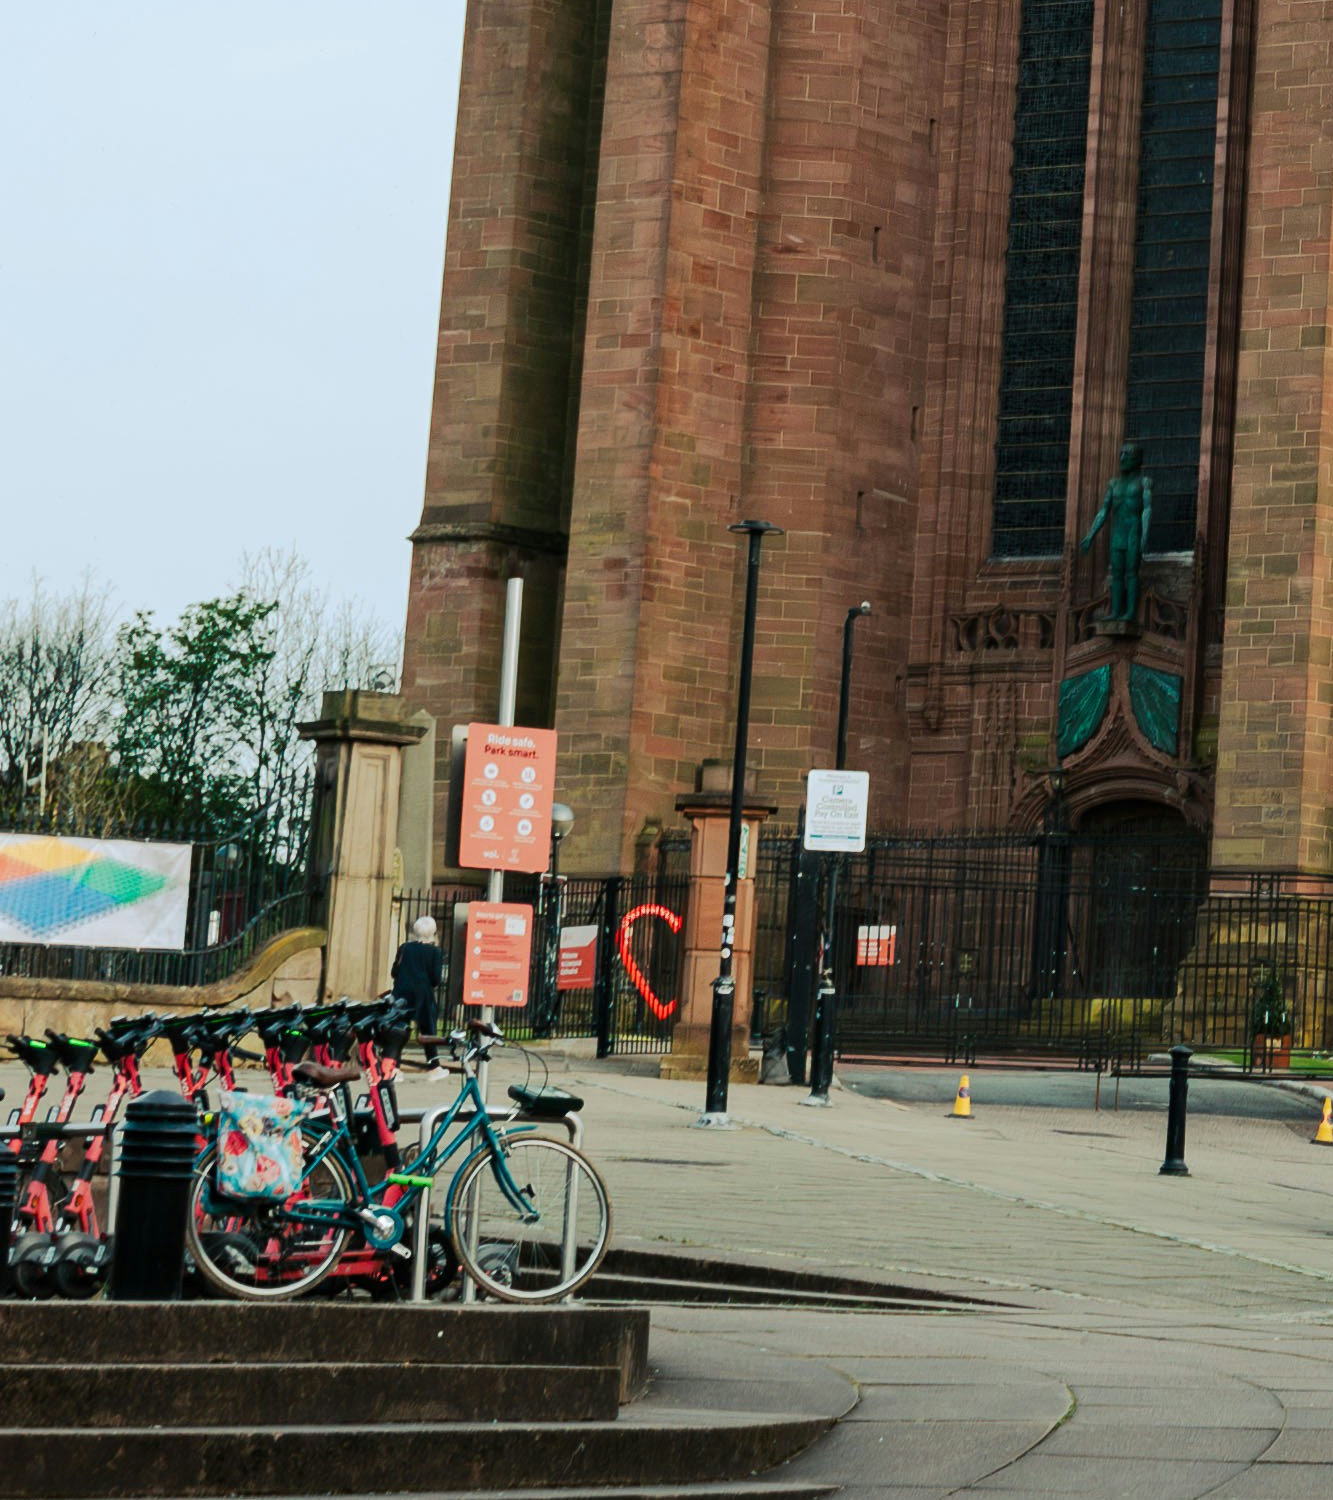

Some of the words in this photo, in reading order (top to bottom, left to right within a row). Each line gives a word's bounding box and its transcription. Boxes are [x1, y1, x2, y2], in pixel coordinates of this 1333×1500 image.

[488, 733, 511, 745] Ride
[485, 744, 506, 755] Park
[508, 749, 539, 760] smart.
